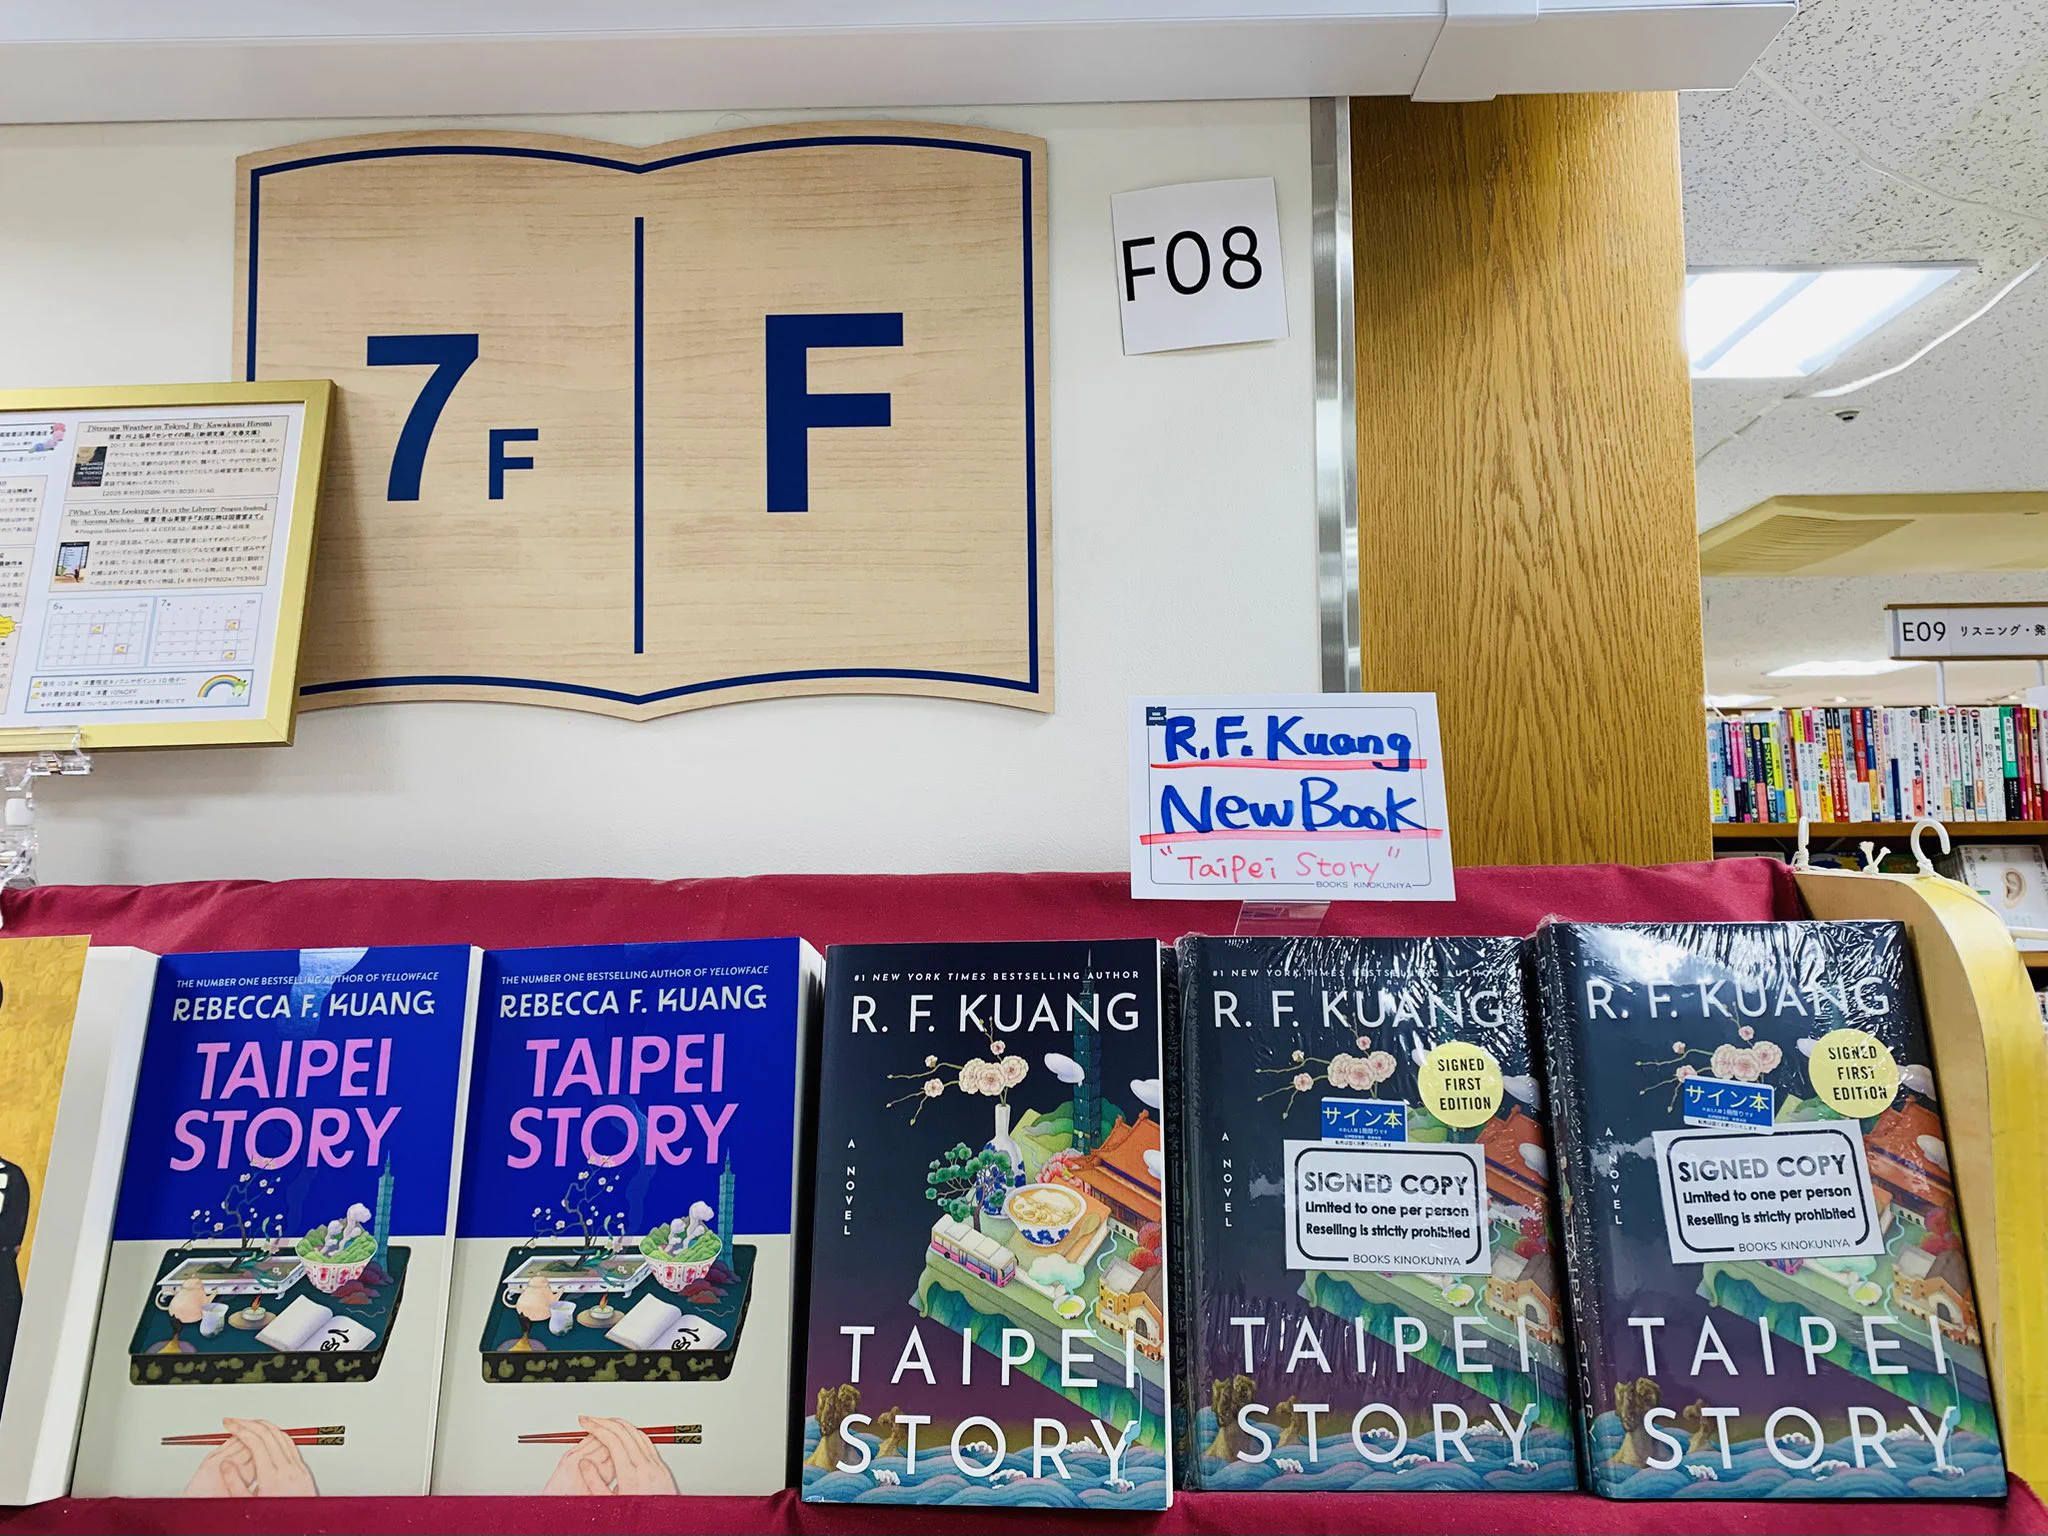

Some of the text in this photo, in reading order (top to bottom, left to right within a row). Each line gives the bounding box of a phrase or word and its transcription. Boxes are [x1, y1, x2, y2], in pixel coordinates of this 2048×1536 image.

[1122, 225, 1263, 301] F08
[765, 312, 904, 513] F
[122, 423, 152, 431] Weather
[1902, 621, 1947, 642] E09
[1164, 715, 1413, 773] R.F. Kuang
[1161, 777, 1428, 834] New Book
[1316, 880, 1413, 890] BOOKS KINOKUNIYA
[176, 971, 440, 989] THE NUMBER ONE BESTSELLING AUTHOR OF YELLOWFACE
[501, 965, 769, 985] THE NUMBER ONE BESTSELLING AUTHOR OF YELLOWFACE
[853, 970, 1140, 982] #1 NEW YORK TIMES BESTSELLING AUTHOR
[1212, 969, 1226, 978] #1
[1230, 969, 1261, 978] NEW
[172, 990, 435, 1022] REBECCA F. KUANG
[499, 983, 767, 1019] REBECCA F. KUANG
[1213, 989, 1505, 1029] R. F. KUANG
[1586, 976, 1891, 1020] R. F. KUANG
[851, 992, 1140, 1034] R. F. KUANG
[526, 1033, 725, 1097] TAIPEI
[1437, 1057, 1486, 1073] SIGNED
[1828, 1046, 1878, 1061] SIGNED
[196, 1038, 393, 1101] TAIPEI
[1836, 1066, 1876, 1081] FIRST
[1445, 1077, 1482, 1092] FIRST
[1832, 1086, 1888, 1102] EDITION
[1439, 1096, 1493, 1112] EDITION
[1685, 1084, 1770, 1113] サイン本
[1322, 1106, 1404, 1130] サイン本
[169, 1106, 402, 1172] STORY
[507, 1103, 740, 1169] STORY
[847, 1138, 856, 1149] A
[1221, 1132, 1229, 1142] A
[1605, 1128, 1613, 1137] A
[1678, 1153, 1847, 1183] SIGNED COPY
[1223, 1159, 1233, 1227] NOVEL
[1303, 1171, 1469, 1196] SIGNED COPY
[1608, 1153, 1623, 1225] NOVEL
[1683, 1184, 1852, 1205] Limited to one per person
[843, 1165, 857, 1236] NOVEL
[1305, 1201, 1469, 1219] Limited to one per person
[1686, 1206, 1856, 1229] Reselling is strictly prohibited
[1306, 1222, 1470, 1241] Reselling is strictly prohibited
[1738, 1238, 1850, 1253] BOOKS KINOKUNIYA
[1353, 1254, 1460, 1267] BOOKS KINOKUNIYA
[839, 1324, 1136, 1390] TAIPEI
[1229, 1316, 1532, 1374] TAIPEI
[1627, 1314, 1948, 1376] TAIPEI
[1235, 1402, 1537, 1464] STORY
[1643, 1406, 1957, 1471] STORY
[834, 1412, 1140, 1483] STORY
